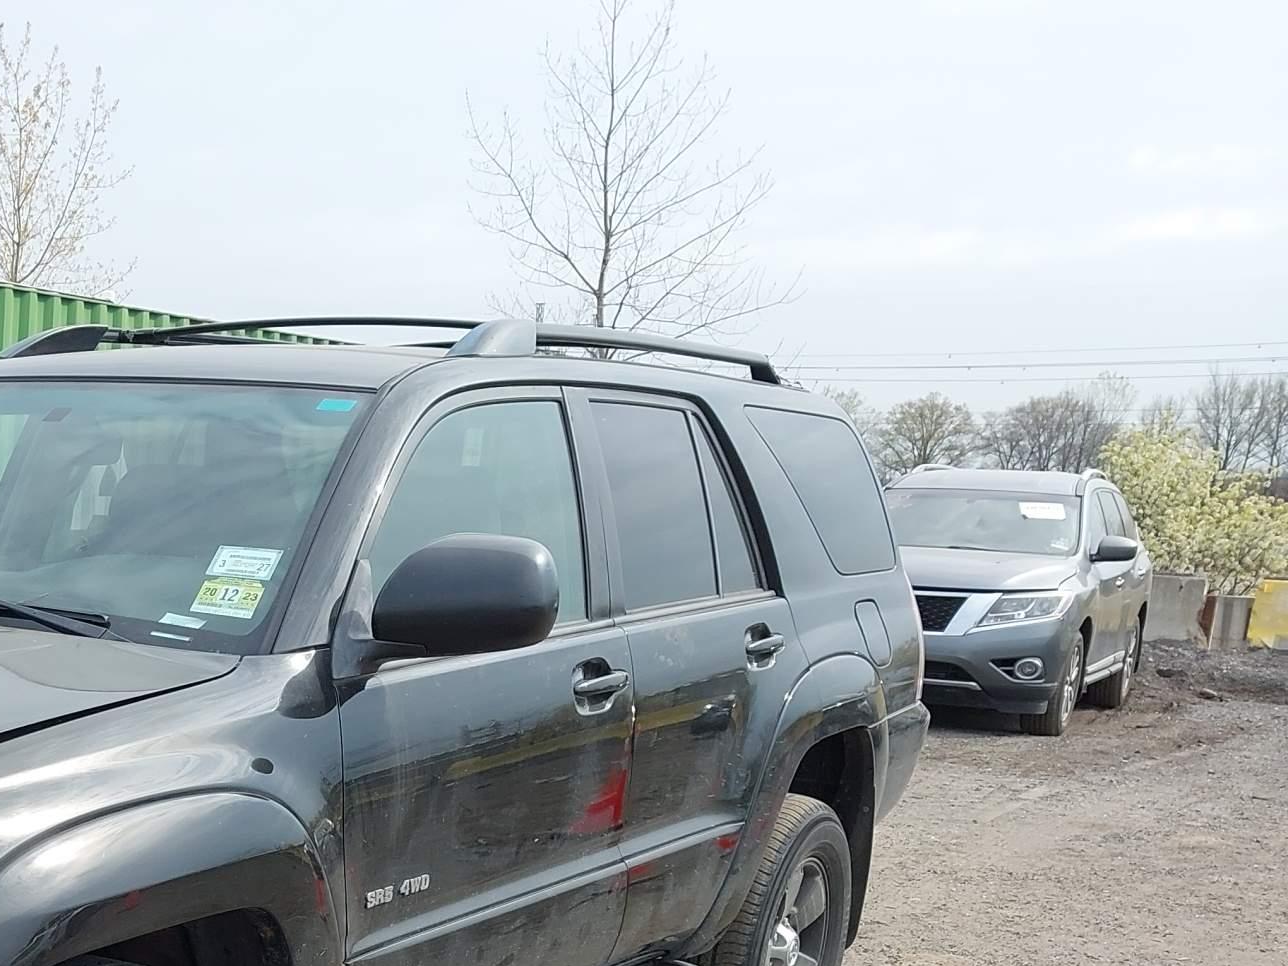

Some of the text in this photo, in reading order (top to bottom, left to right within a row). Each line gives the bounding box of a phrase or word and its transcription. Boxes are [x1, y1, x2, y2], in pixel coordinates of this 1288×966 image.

[219, 559, 227, 568] 3
[256, 563, 271, 572] 27
[203, 587, 259, 602] 20 12 23
[366, 874, 430, 909] SR5 4WD
